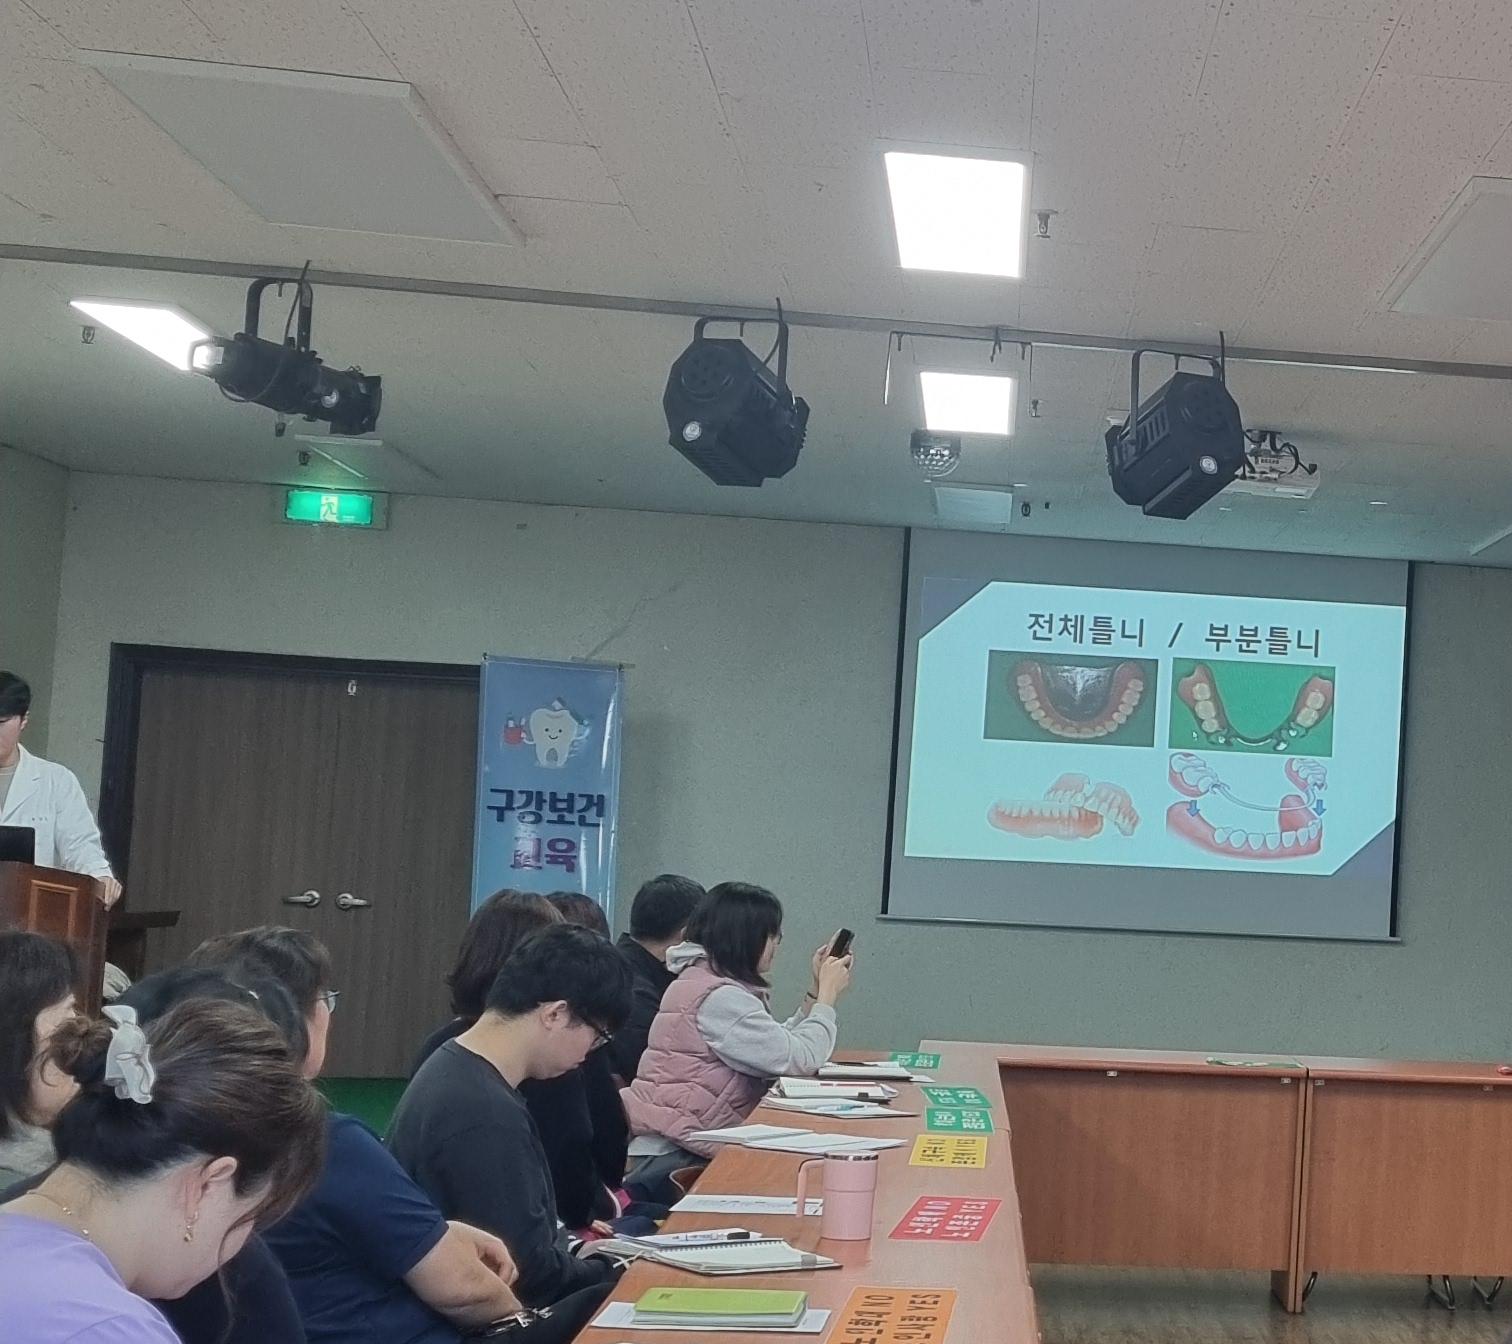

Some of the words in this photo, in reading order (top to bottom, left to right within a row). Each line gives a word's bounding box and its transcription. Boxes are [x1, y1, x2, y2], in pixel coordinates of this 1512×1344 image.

[1027, 612, 1145, 648] 전체틀니
[1167, 622, 1184, 648] /
[1204, 622, 1321, 658] 부분틀니
[487, 787, 606, 828] 구강보건
[510, 836, 578, 874] 교육
[861, 1294, 895, 1308] NO
[906, 1294, 942, 1312] YES
